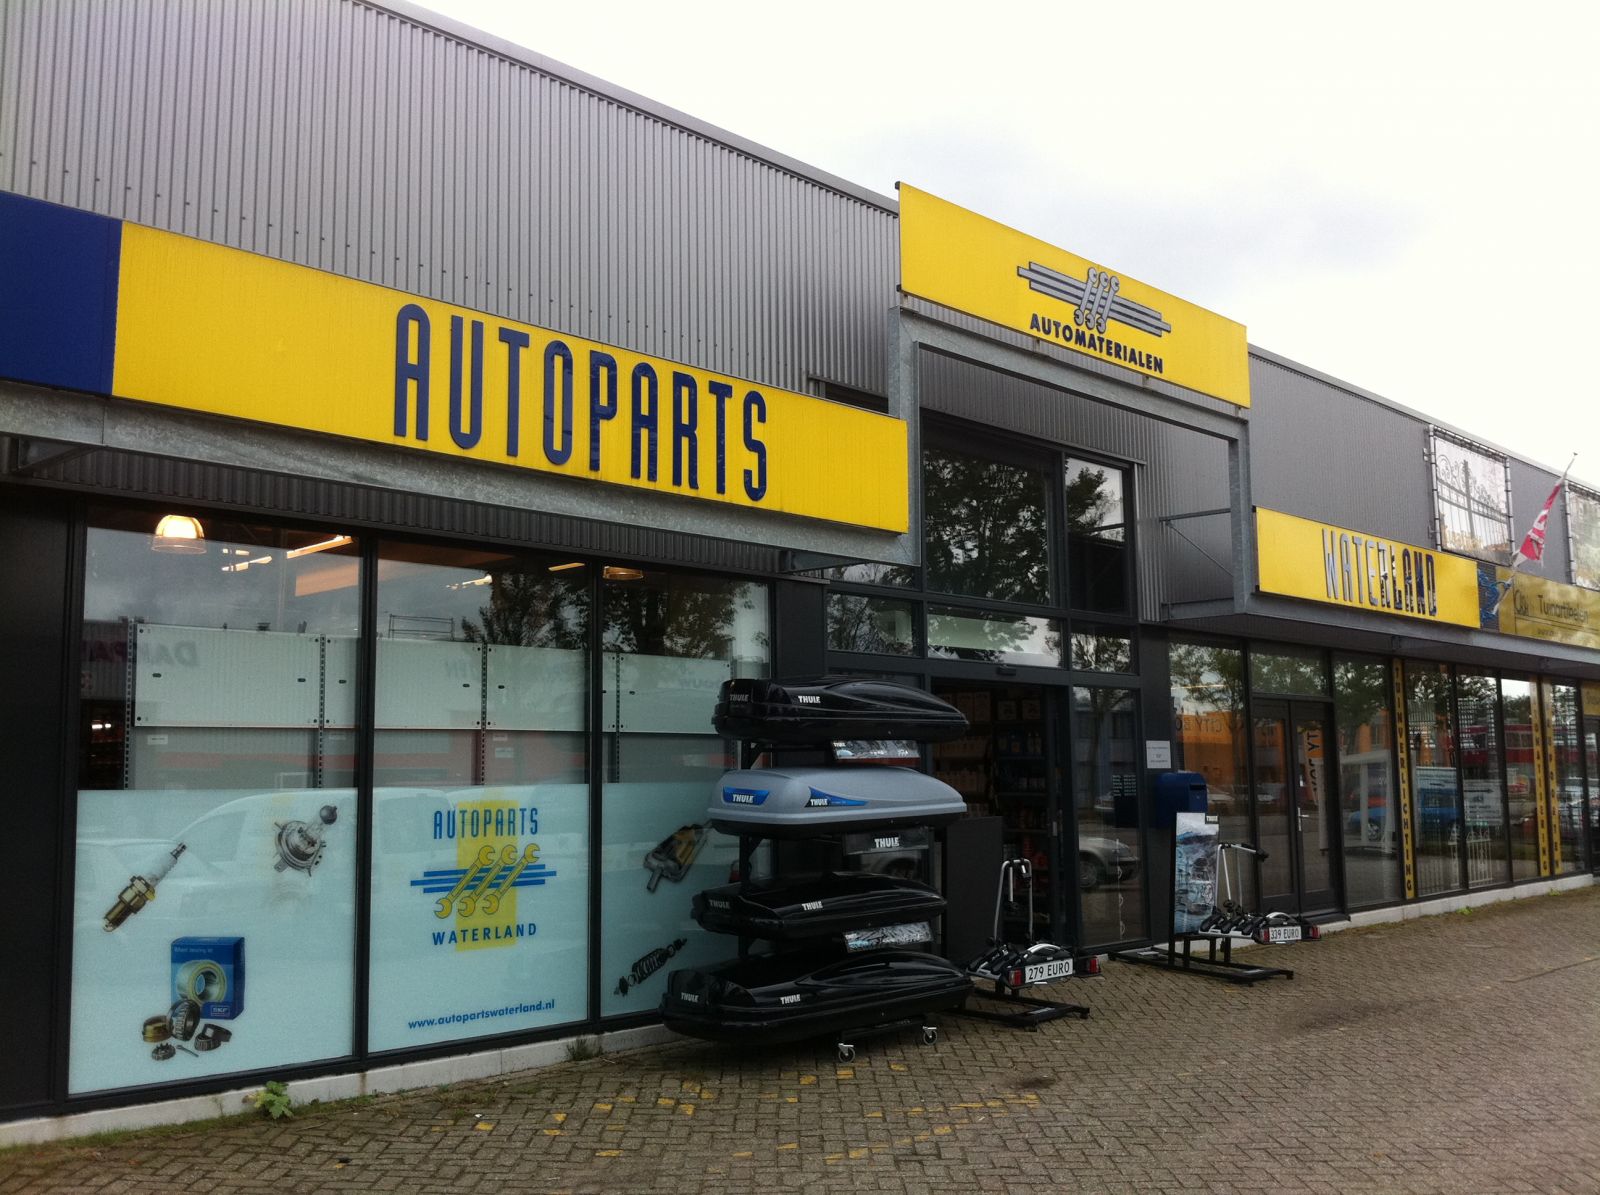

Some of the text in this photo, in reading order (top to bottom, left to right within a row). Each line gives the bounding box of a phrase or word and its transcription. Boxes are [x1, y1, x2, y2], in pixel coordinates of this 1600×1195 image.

[1030, 313, 1163, 374] AUTOMATERIALEN
[394, 303, 767, 502] AUTOPARTS
[1322, 528, 1437, 617] WATERLAND
[798, 695, 821, 704] THULE
[1394, 667, 1413, 891] TUINVERLICHTING
[732, 794, 754, 804] THULE
[810, 798, 828, 807] THULE
[433, 808, 538, 840] AUTOPARTS
[874, 837, 900, 849] THULE
[709, 899, 731, 910] THULE
[802, 900, 823, 911] THULE
[432, 923, 537, 946] WATERLAND
[1270, 926, 1301, 941] 339 EURO
[1028, 960, 1070, 981] 279 EURO
[681, 992, 699, 1003] THULE
[779, 993, 801, 1005] THULE
[408, 999, 555, 1030] www.autopartswaterland.nl
